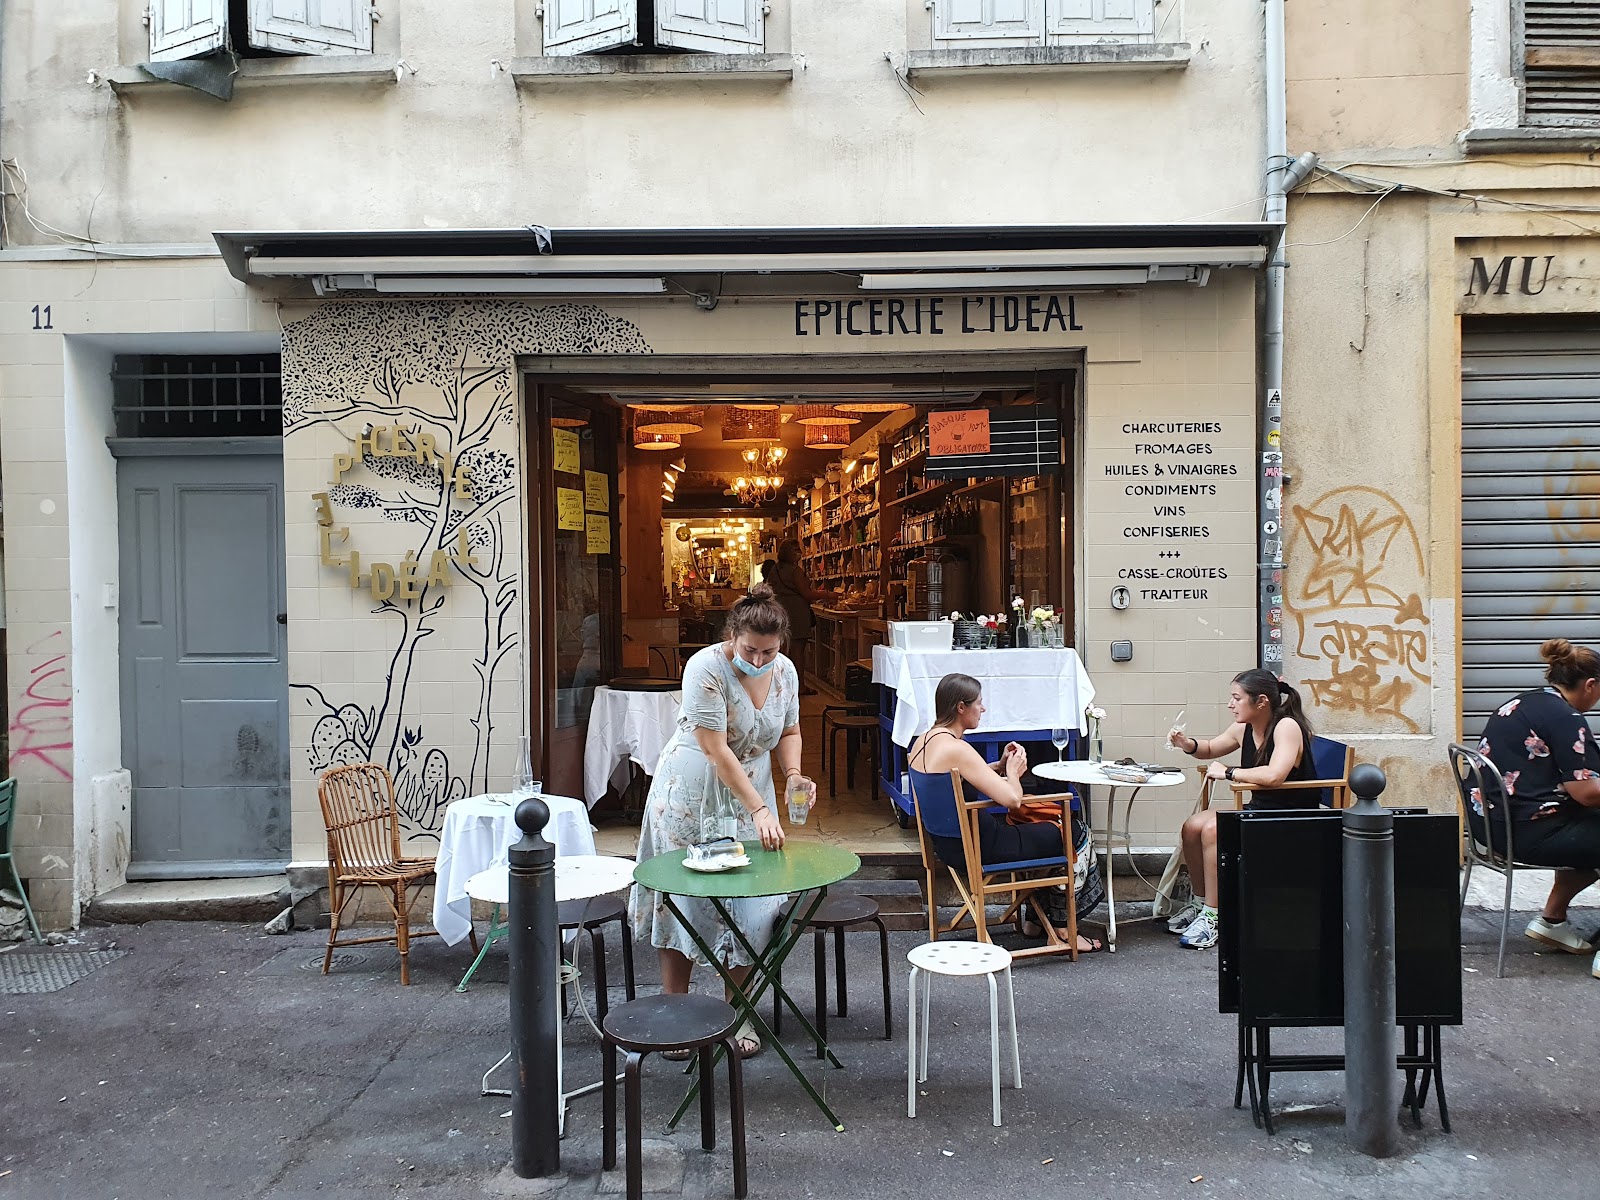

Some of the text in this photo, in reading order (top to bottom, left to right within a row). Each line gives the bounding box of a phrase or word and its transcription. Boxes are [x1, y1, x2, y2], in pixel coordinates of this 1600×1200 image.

[1463, 255, 1556, 296] MU
[31, 304, 54, 329] 11
[795, 297, 944, 336] EPICERIE
[1122, 422, 1222, 434] CHARCUTERIES
[936, 443, 988, 454] OBLIGATOIRE
[1135, 443, 1213, 455] FROMAGES
[1105, 463, 1238, 477] HUILES & VINAIGRES
[1125, 484, 1217, 496] CONDIMENTS
[1153, 505, 1186, 517] VINS
[1123, 526, 1210, 538] CONFISERIES
[1118, 565, 1228, 580] CASSE-CROÛTES
[1139, 588, 1209, 600] TRAITEUR
